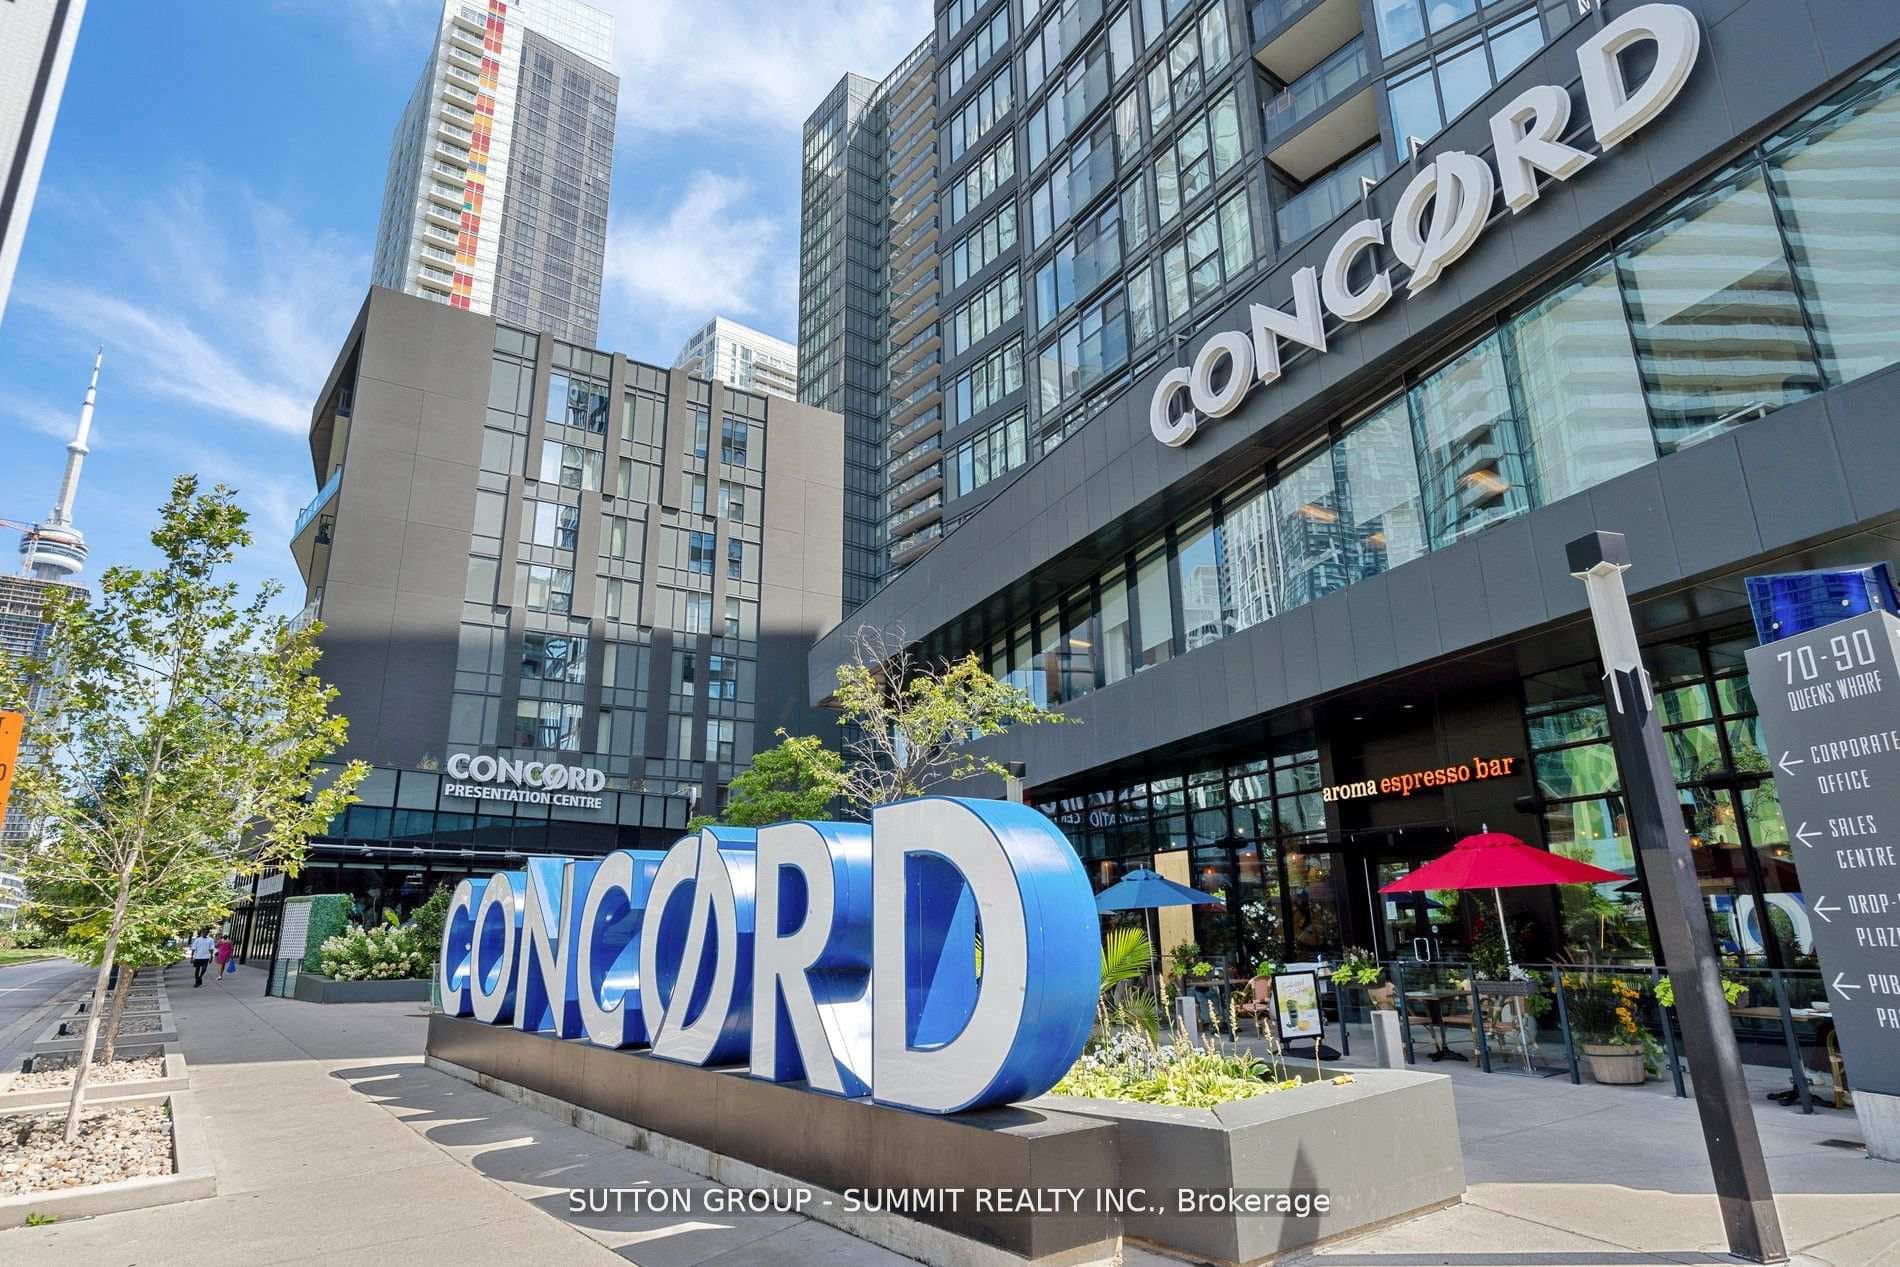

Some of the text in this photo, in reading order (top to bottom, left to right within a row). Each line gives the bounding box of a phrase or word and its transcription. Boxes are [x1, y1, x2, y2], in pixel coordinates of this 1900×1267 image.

[1150, 3, 1700, 447] CONCORD
[1777, 628, 1876, 685] 70-90
[1787, 670, 1882, 712] QUEENS WHARF
[1810, 730, 1900, 764] CORPORATE
[447, 753, 606, 792] CONCORD
[1322, 755, 1516, 802] aroma espresso bar
[1818, 769, 1871, 794] OFFICE
[444, 784, 602, 809] PRESENTATION CENTRE
[1829, 814, 1877, 838] SALES
[1836, 846, 1897, 869] CENTRE
[1848, 893, 1900, 914] DROP-
[441, 795, 1100, 1114] CONCORD
[1876, 1007, 1900, 1030] PA
